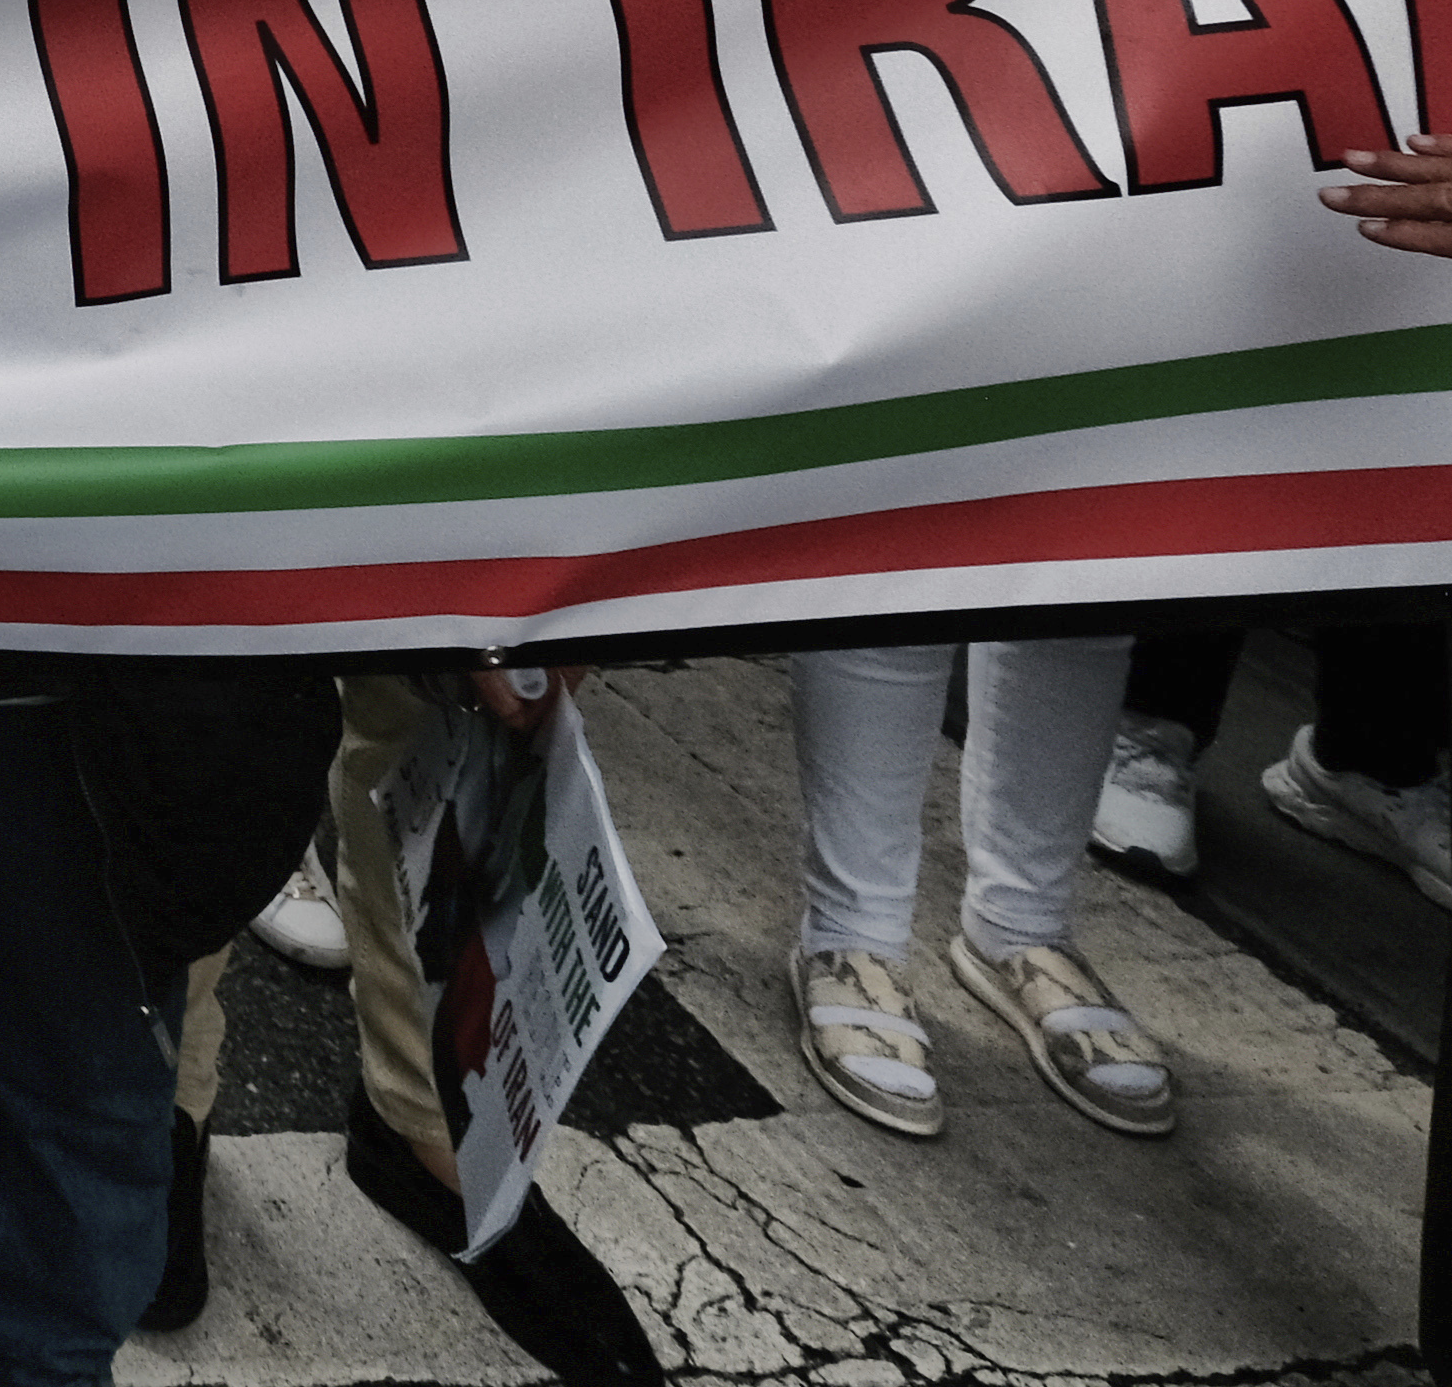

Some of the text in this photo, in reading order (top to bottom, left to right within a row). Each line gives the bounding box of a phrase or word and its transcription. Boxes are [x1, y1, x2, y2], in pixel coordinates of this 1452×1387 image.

[577, 845, 630, 983] STAND
[493, 998, 541, 1164] OF IRAN
